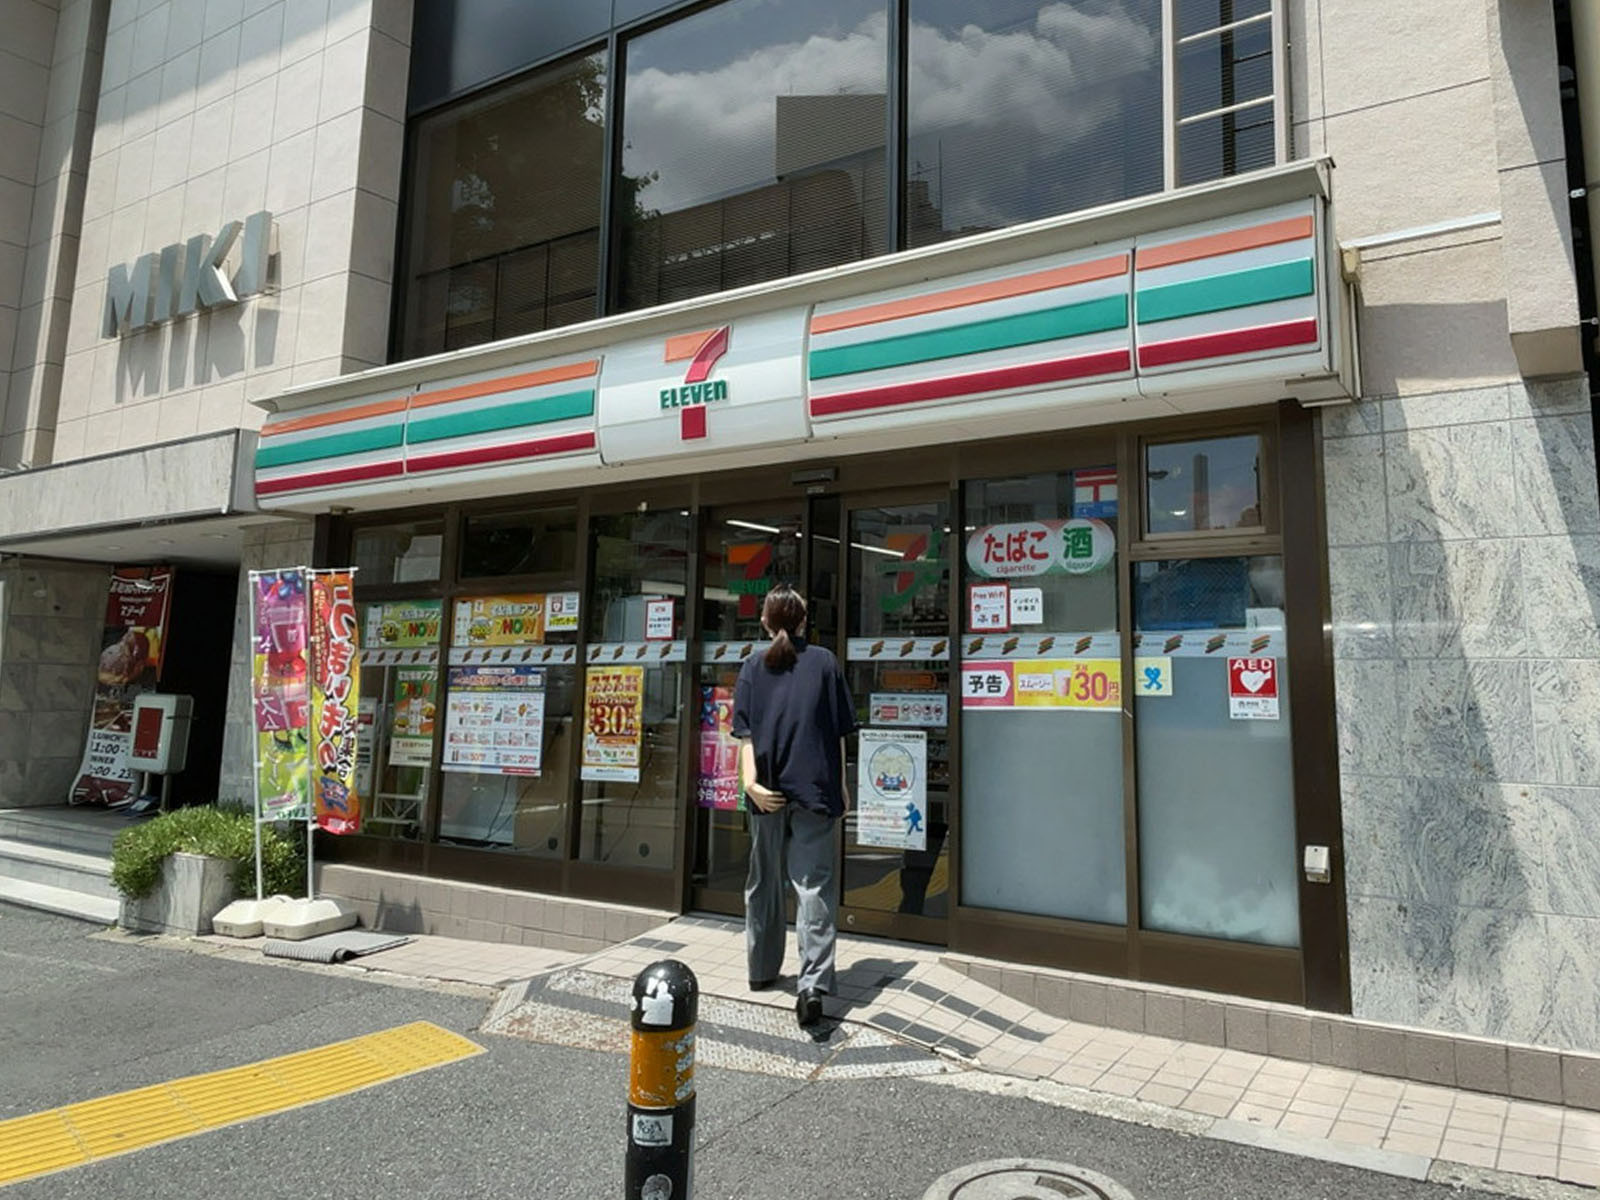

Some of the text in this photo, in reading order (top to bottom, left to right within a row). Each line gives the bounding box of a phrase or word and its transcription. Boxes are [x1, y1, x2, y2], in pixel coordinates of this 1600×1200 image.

[102, 211, 273, 339] MIKI
[985, 530, 1049, 563] たばこ
[1063, 527, 1093, 559] 酒
[1232, 659, 1272, 671] AED
[969, 674, 1002, 693] 予告
